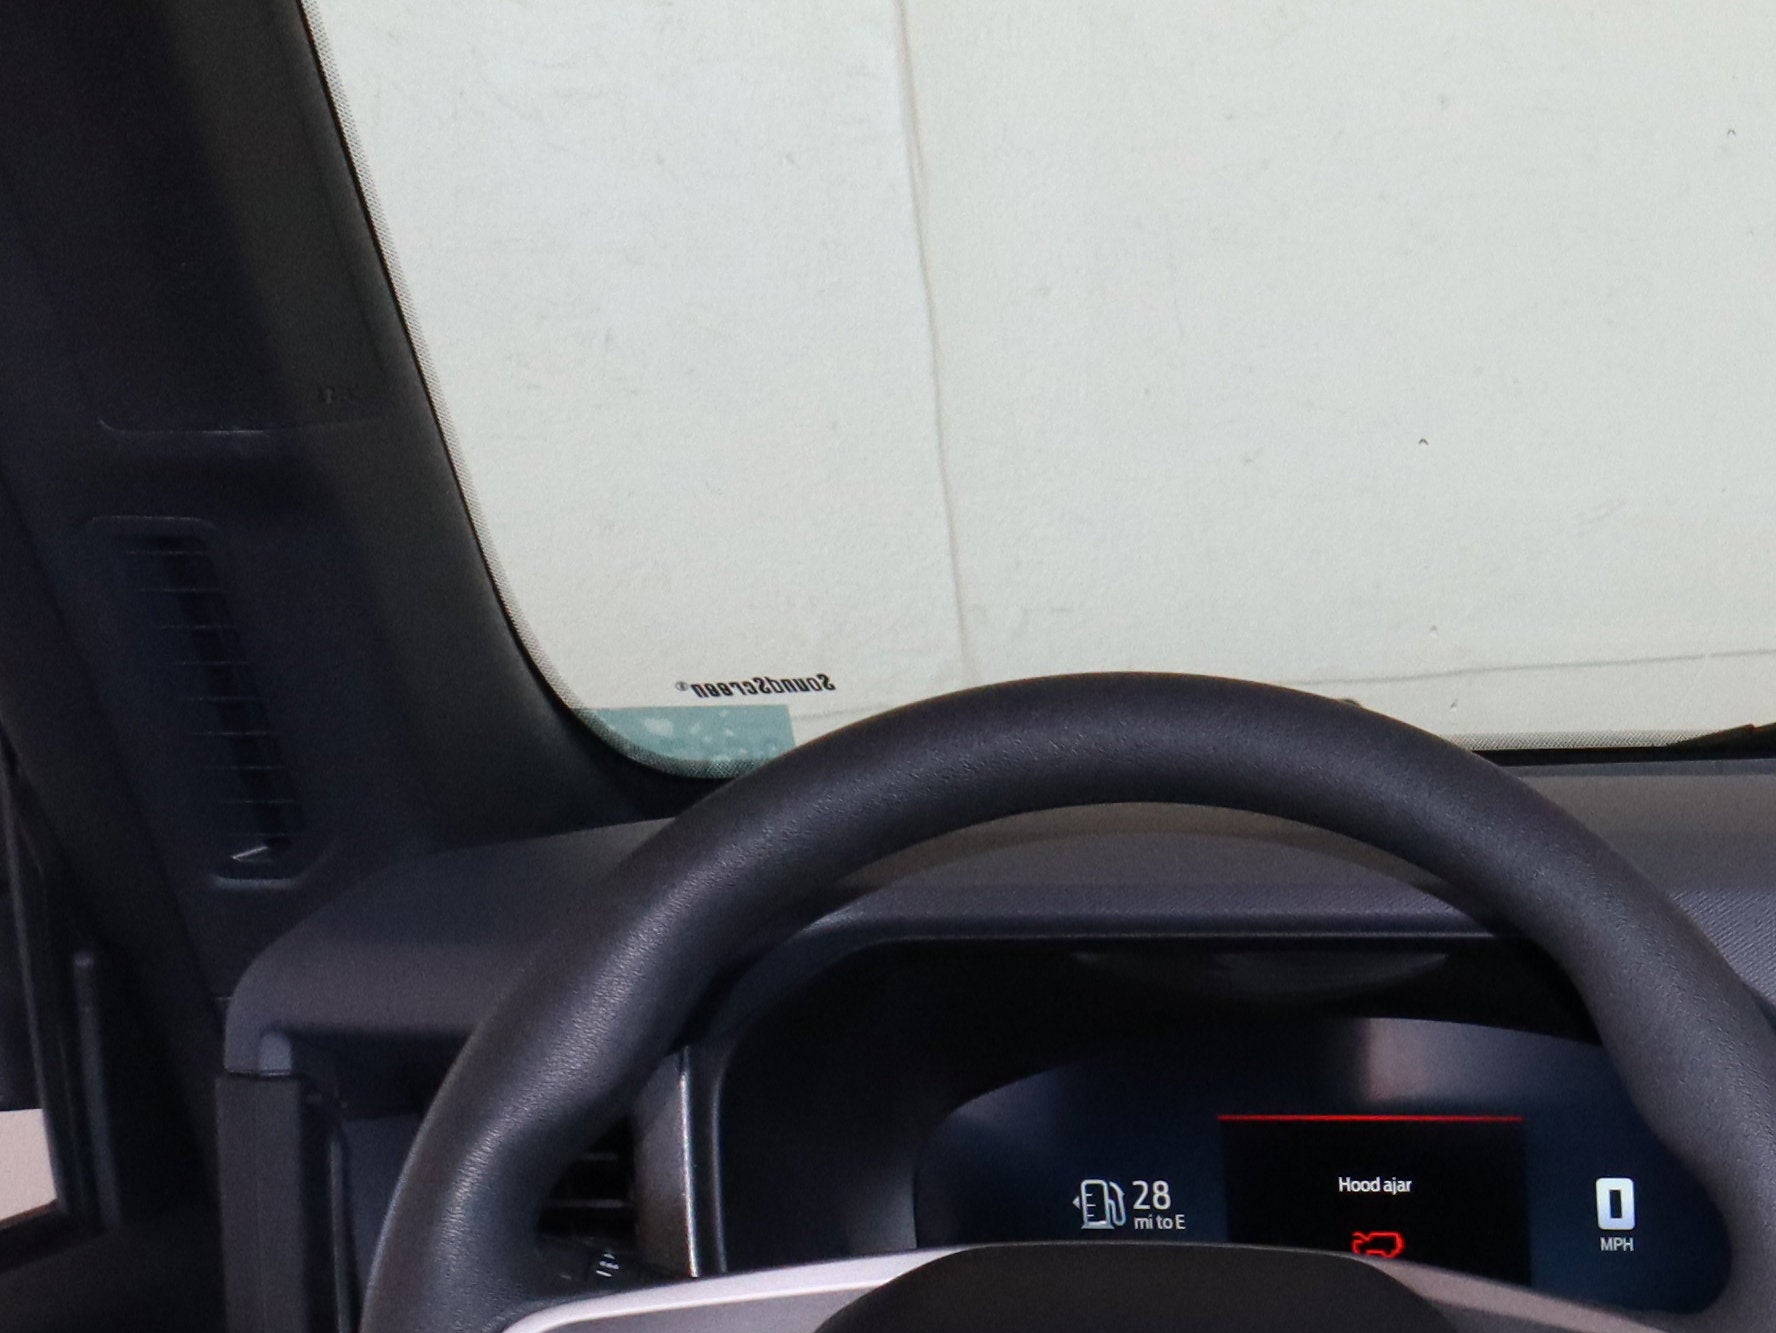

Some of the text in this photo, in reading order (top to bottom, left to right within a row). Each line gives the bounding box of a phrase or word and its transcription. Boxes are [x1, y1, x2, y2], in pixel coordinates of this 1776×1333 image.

[1133, 1180, 1171, 1211] 28
[1337, 1175, 1413, 1197] Hood ajar
[1595, 1177, 1636, 1231] 0
[1133, 1214, 1186, 1230] mi to E
[1600, 1237, 1634, 1252] MPH
